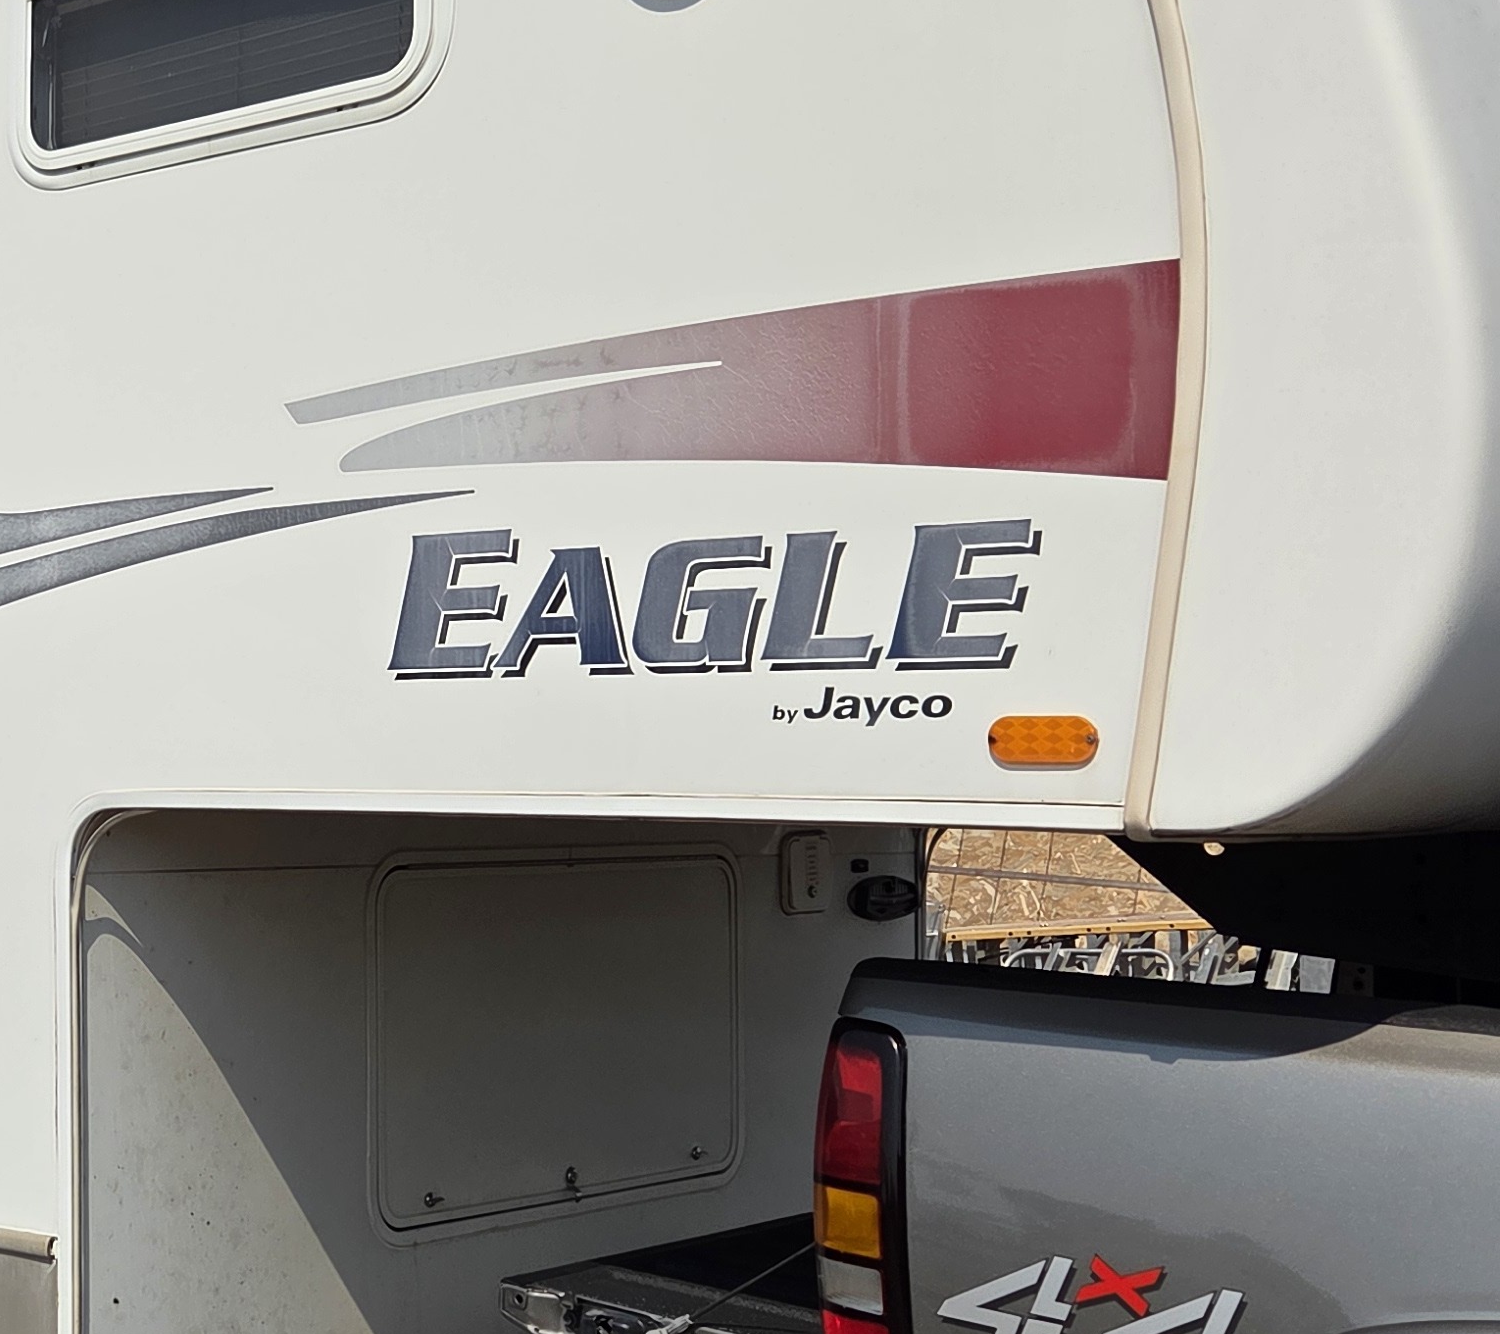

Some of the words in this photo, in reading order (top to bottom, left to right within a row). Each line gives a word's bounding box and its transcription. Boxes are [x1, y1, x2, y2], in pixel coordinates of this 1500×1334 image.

[387, 519, 1042, 680] EAGLE
[772, 705, 798, 724] by
[803, 686, 953, 727] Jayco
